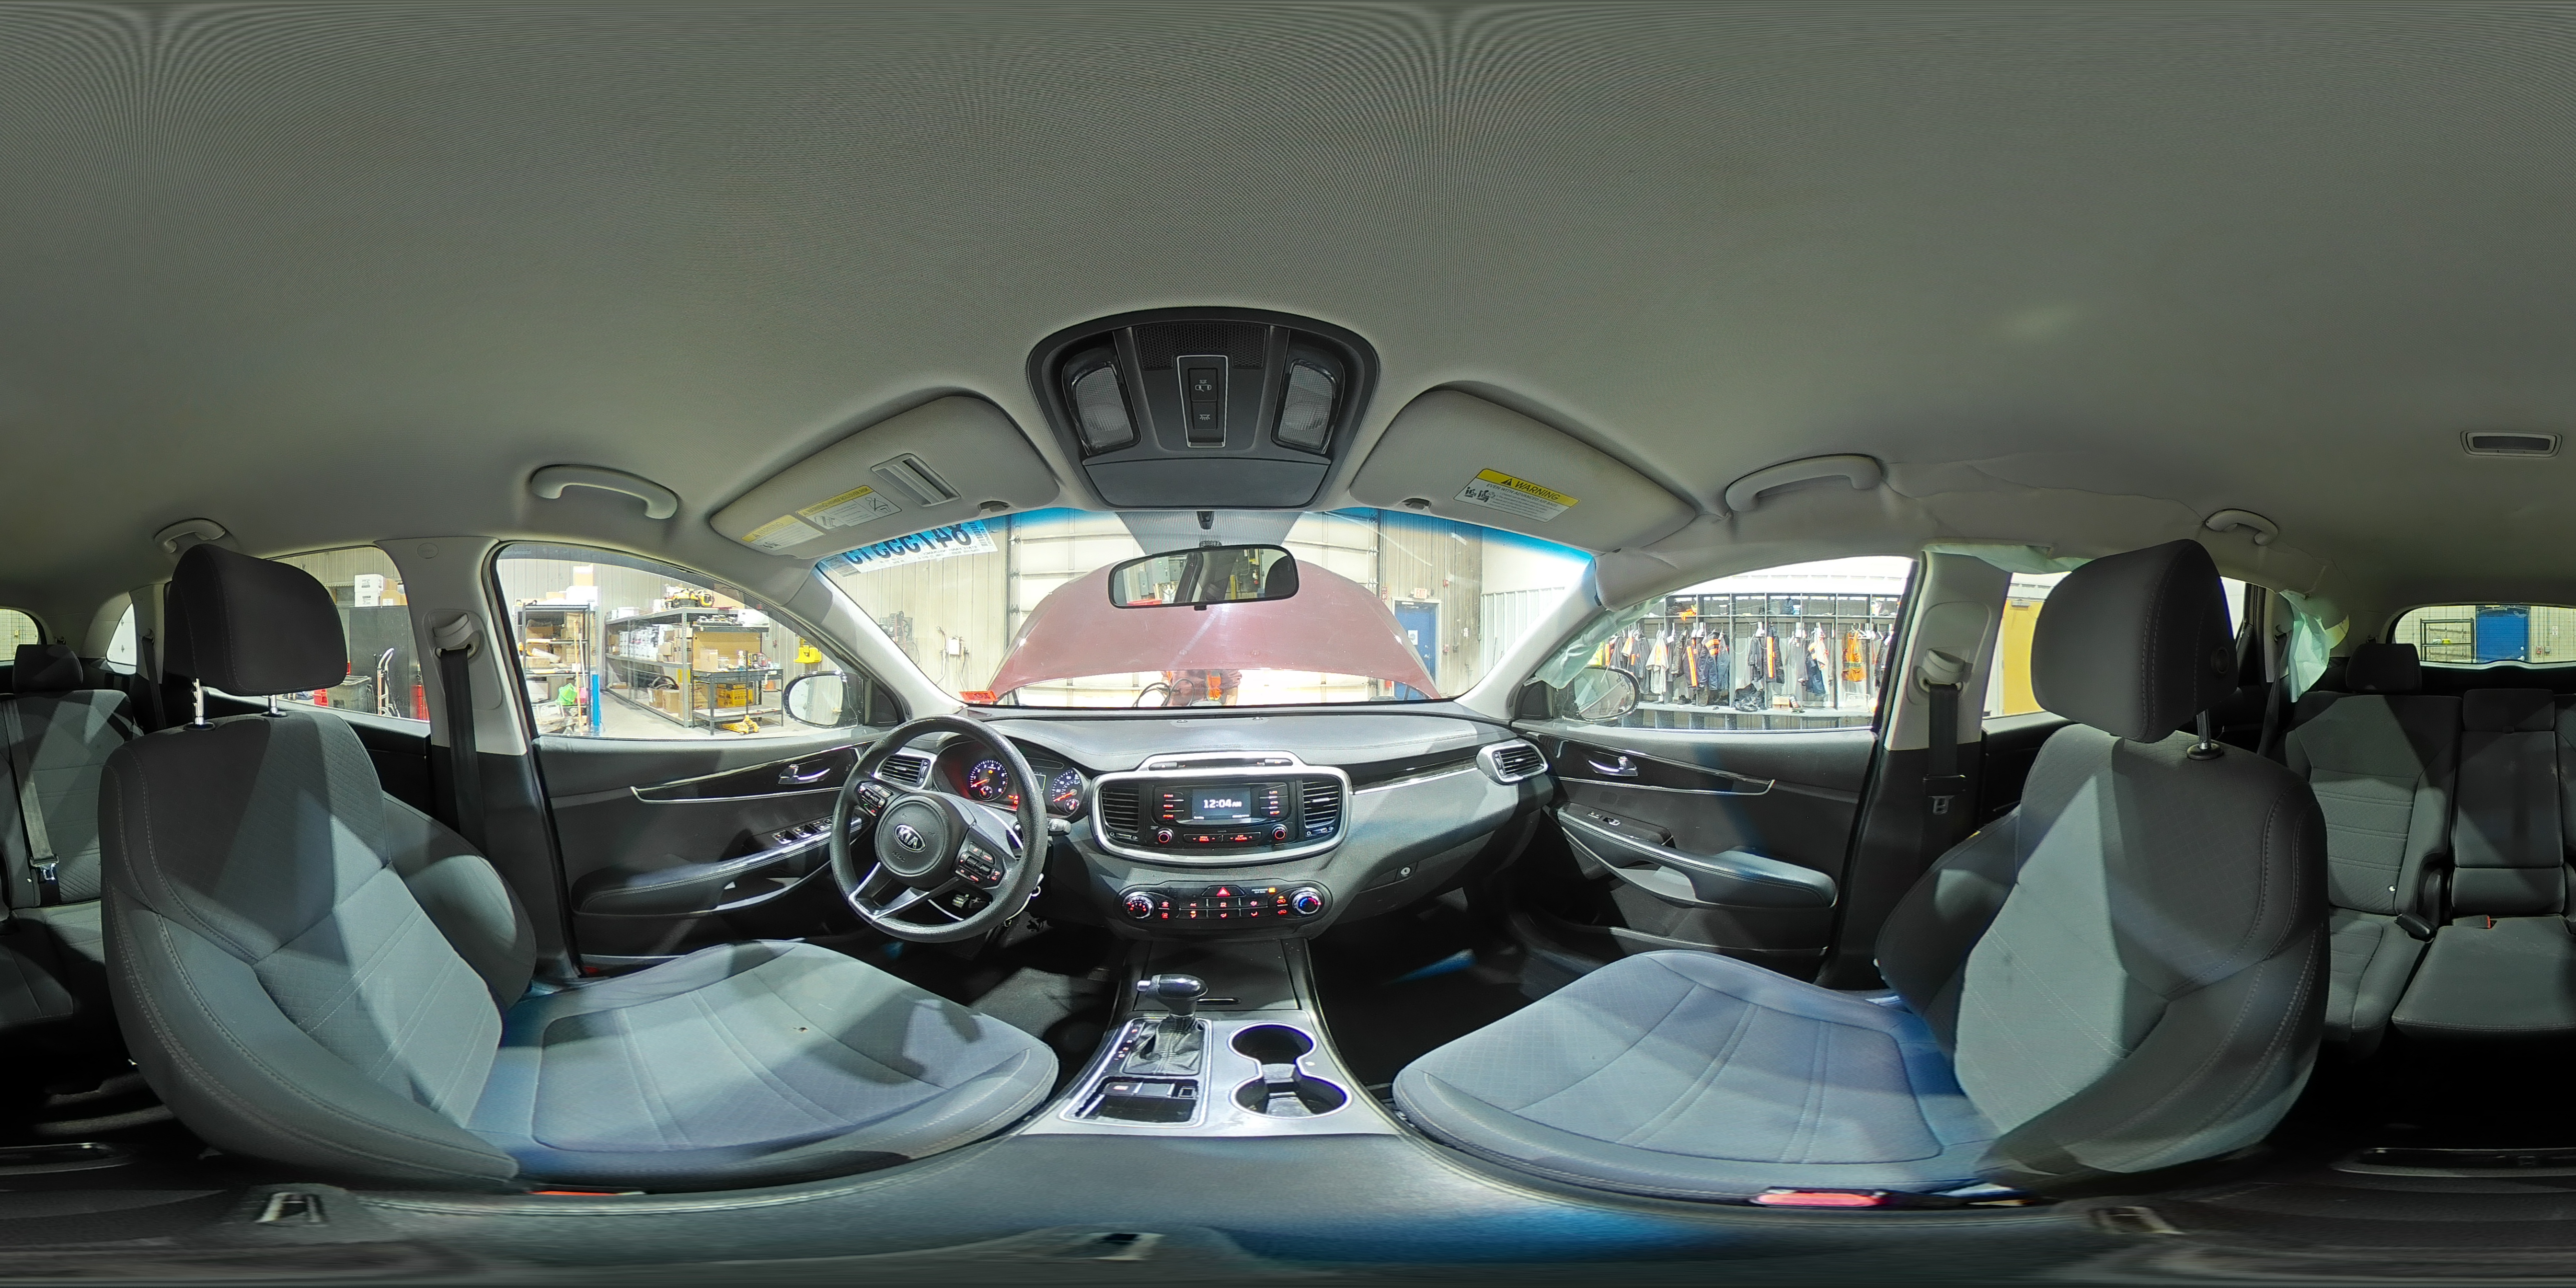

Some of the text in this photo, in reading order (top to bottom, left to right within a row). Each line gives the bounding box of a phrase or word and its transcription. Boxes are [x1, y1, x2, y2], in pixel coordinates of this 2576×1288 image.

[841, 490, 860, 501] ROLLOVER
[1514, 490, 1540, 502] ADVANCED
[1515, 481, 1560, 500] WARNING
[756, 522, 784, 536] WARNING
[1416, 589, 1426, 598] EXIT
[897, 828, 919, 849] KIA
